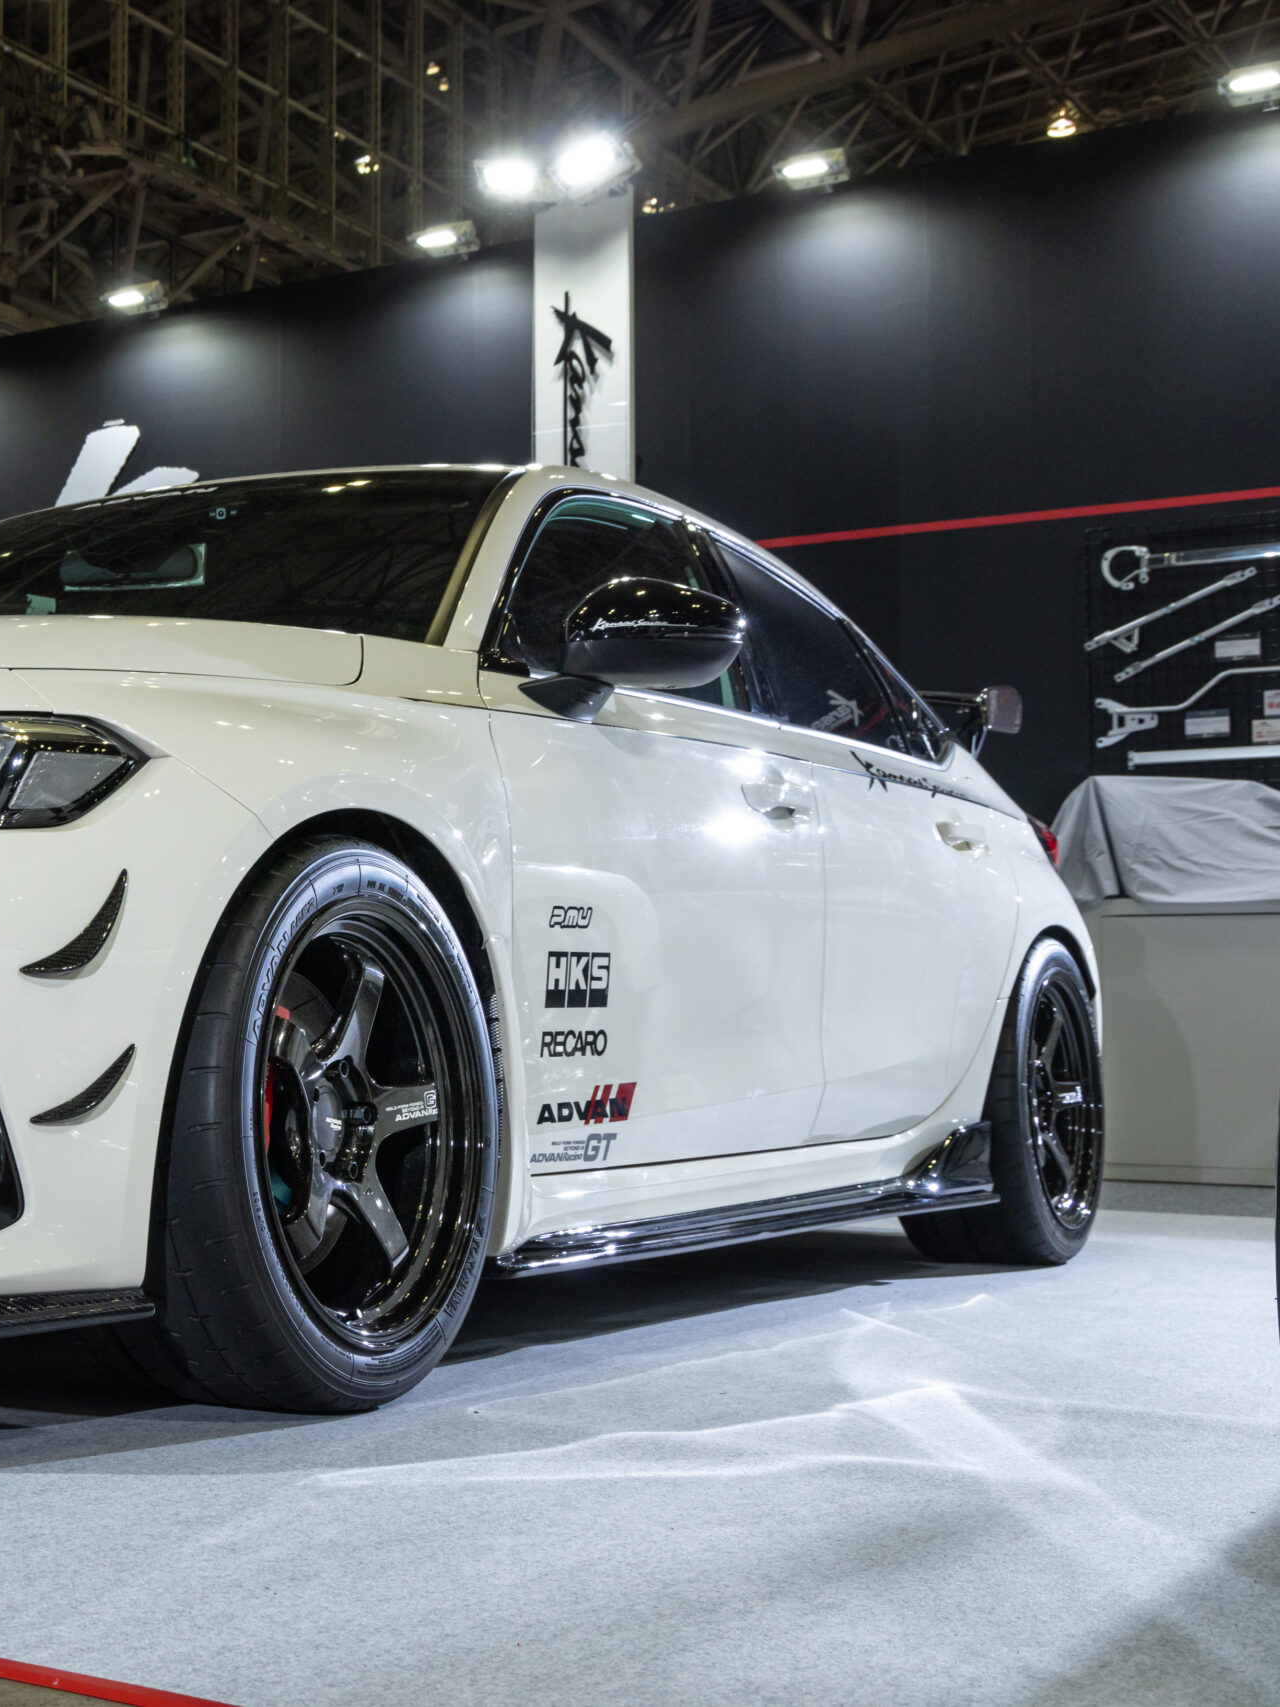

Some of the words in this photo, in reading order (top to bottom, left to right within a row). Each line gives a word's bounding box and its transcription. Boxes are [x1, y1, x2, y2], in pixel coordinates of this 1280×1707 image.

[546, 953, 610, 996] HKS
[539, 1029, 608, 1058] RECARO
[536, 1097, 628, 1126] ADVAN
[583, 1132, 618, 1163] GT
